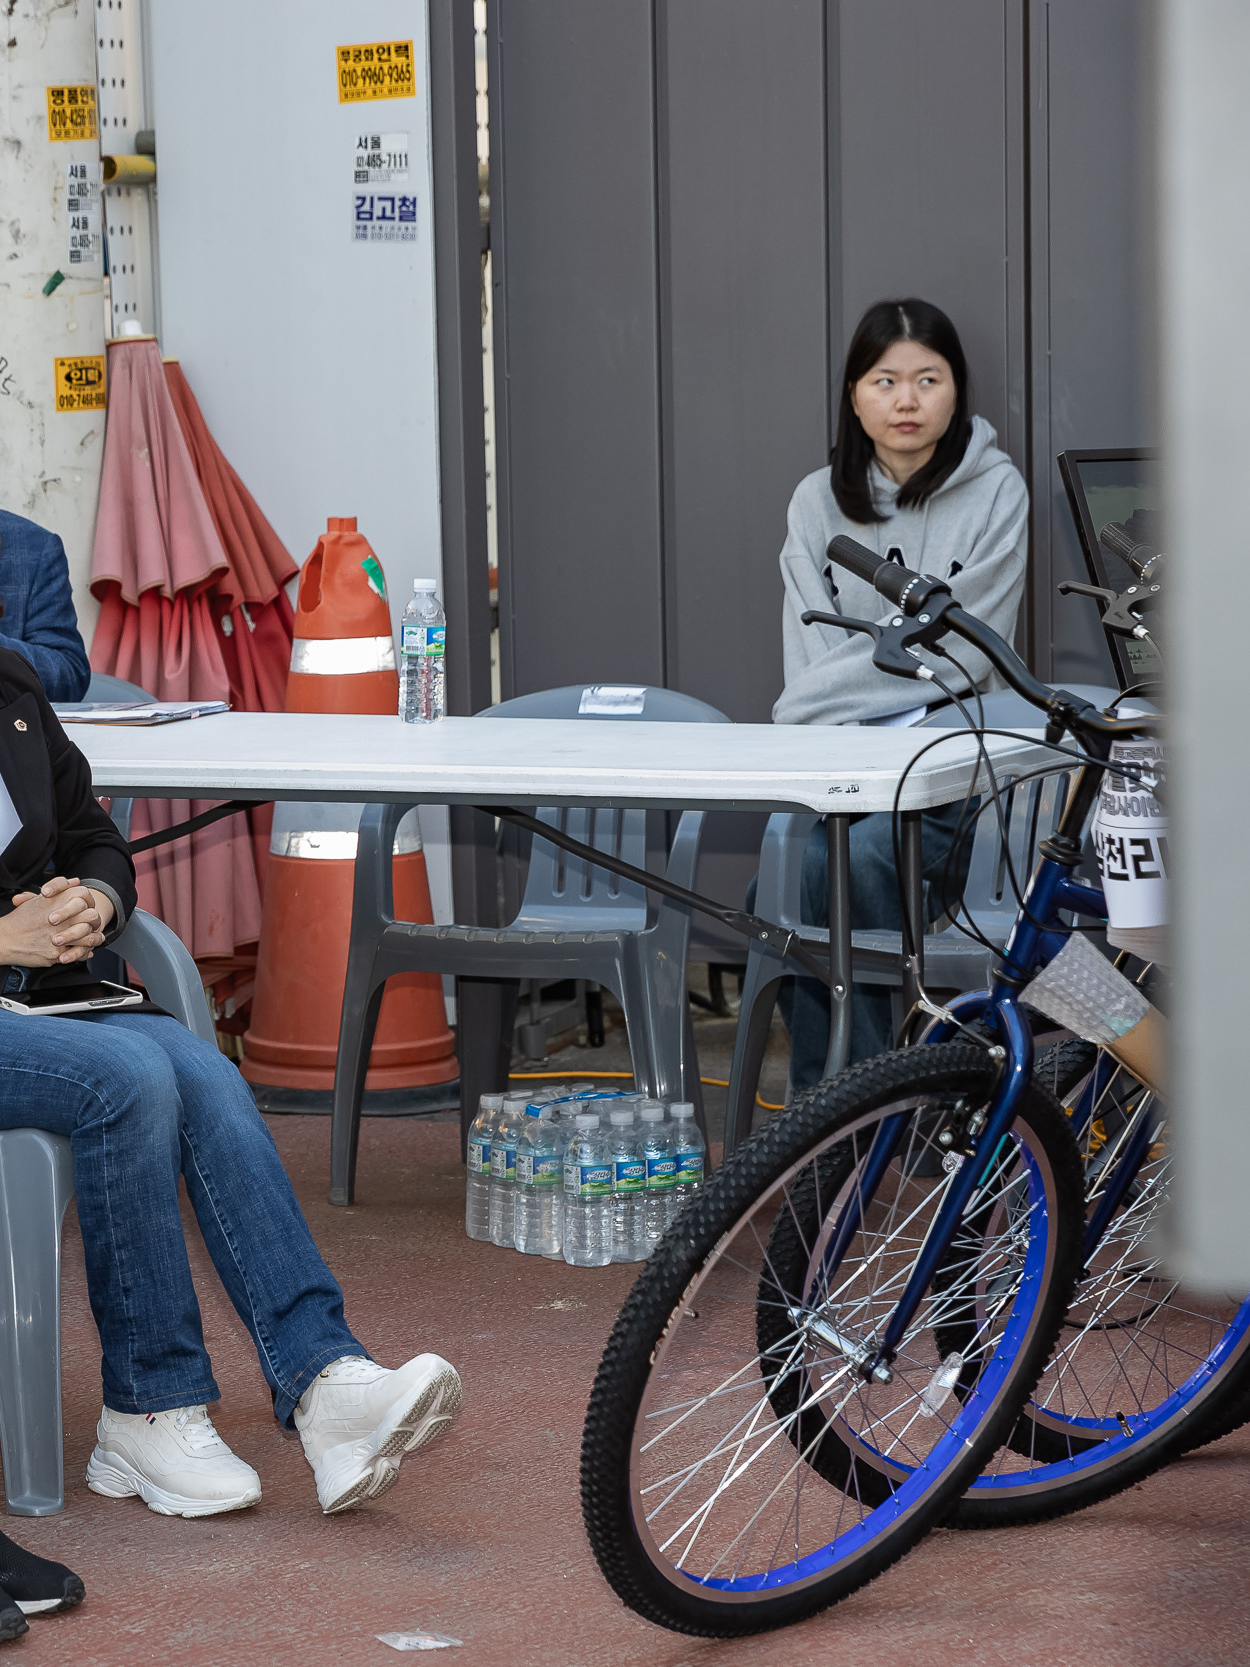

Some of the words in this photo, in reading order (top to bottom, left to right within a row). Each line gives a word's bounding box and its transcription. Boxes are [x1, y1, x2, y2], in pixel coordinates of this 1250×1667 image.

[341, 63, 411, 88] 010-9960-9365
[356, 135, 381, 150] 서울
[70, 165, 87, 179] 서울
[355, 195, 417, 222] 김고철
[71, 216, 88, 231] 서울
